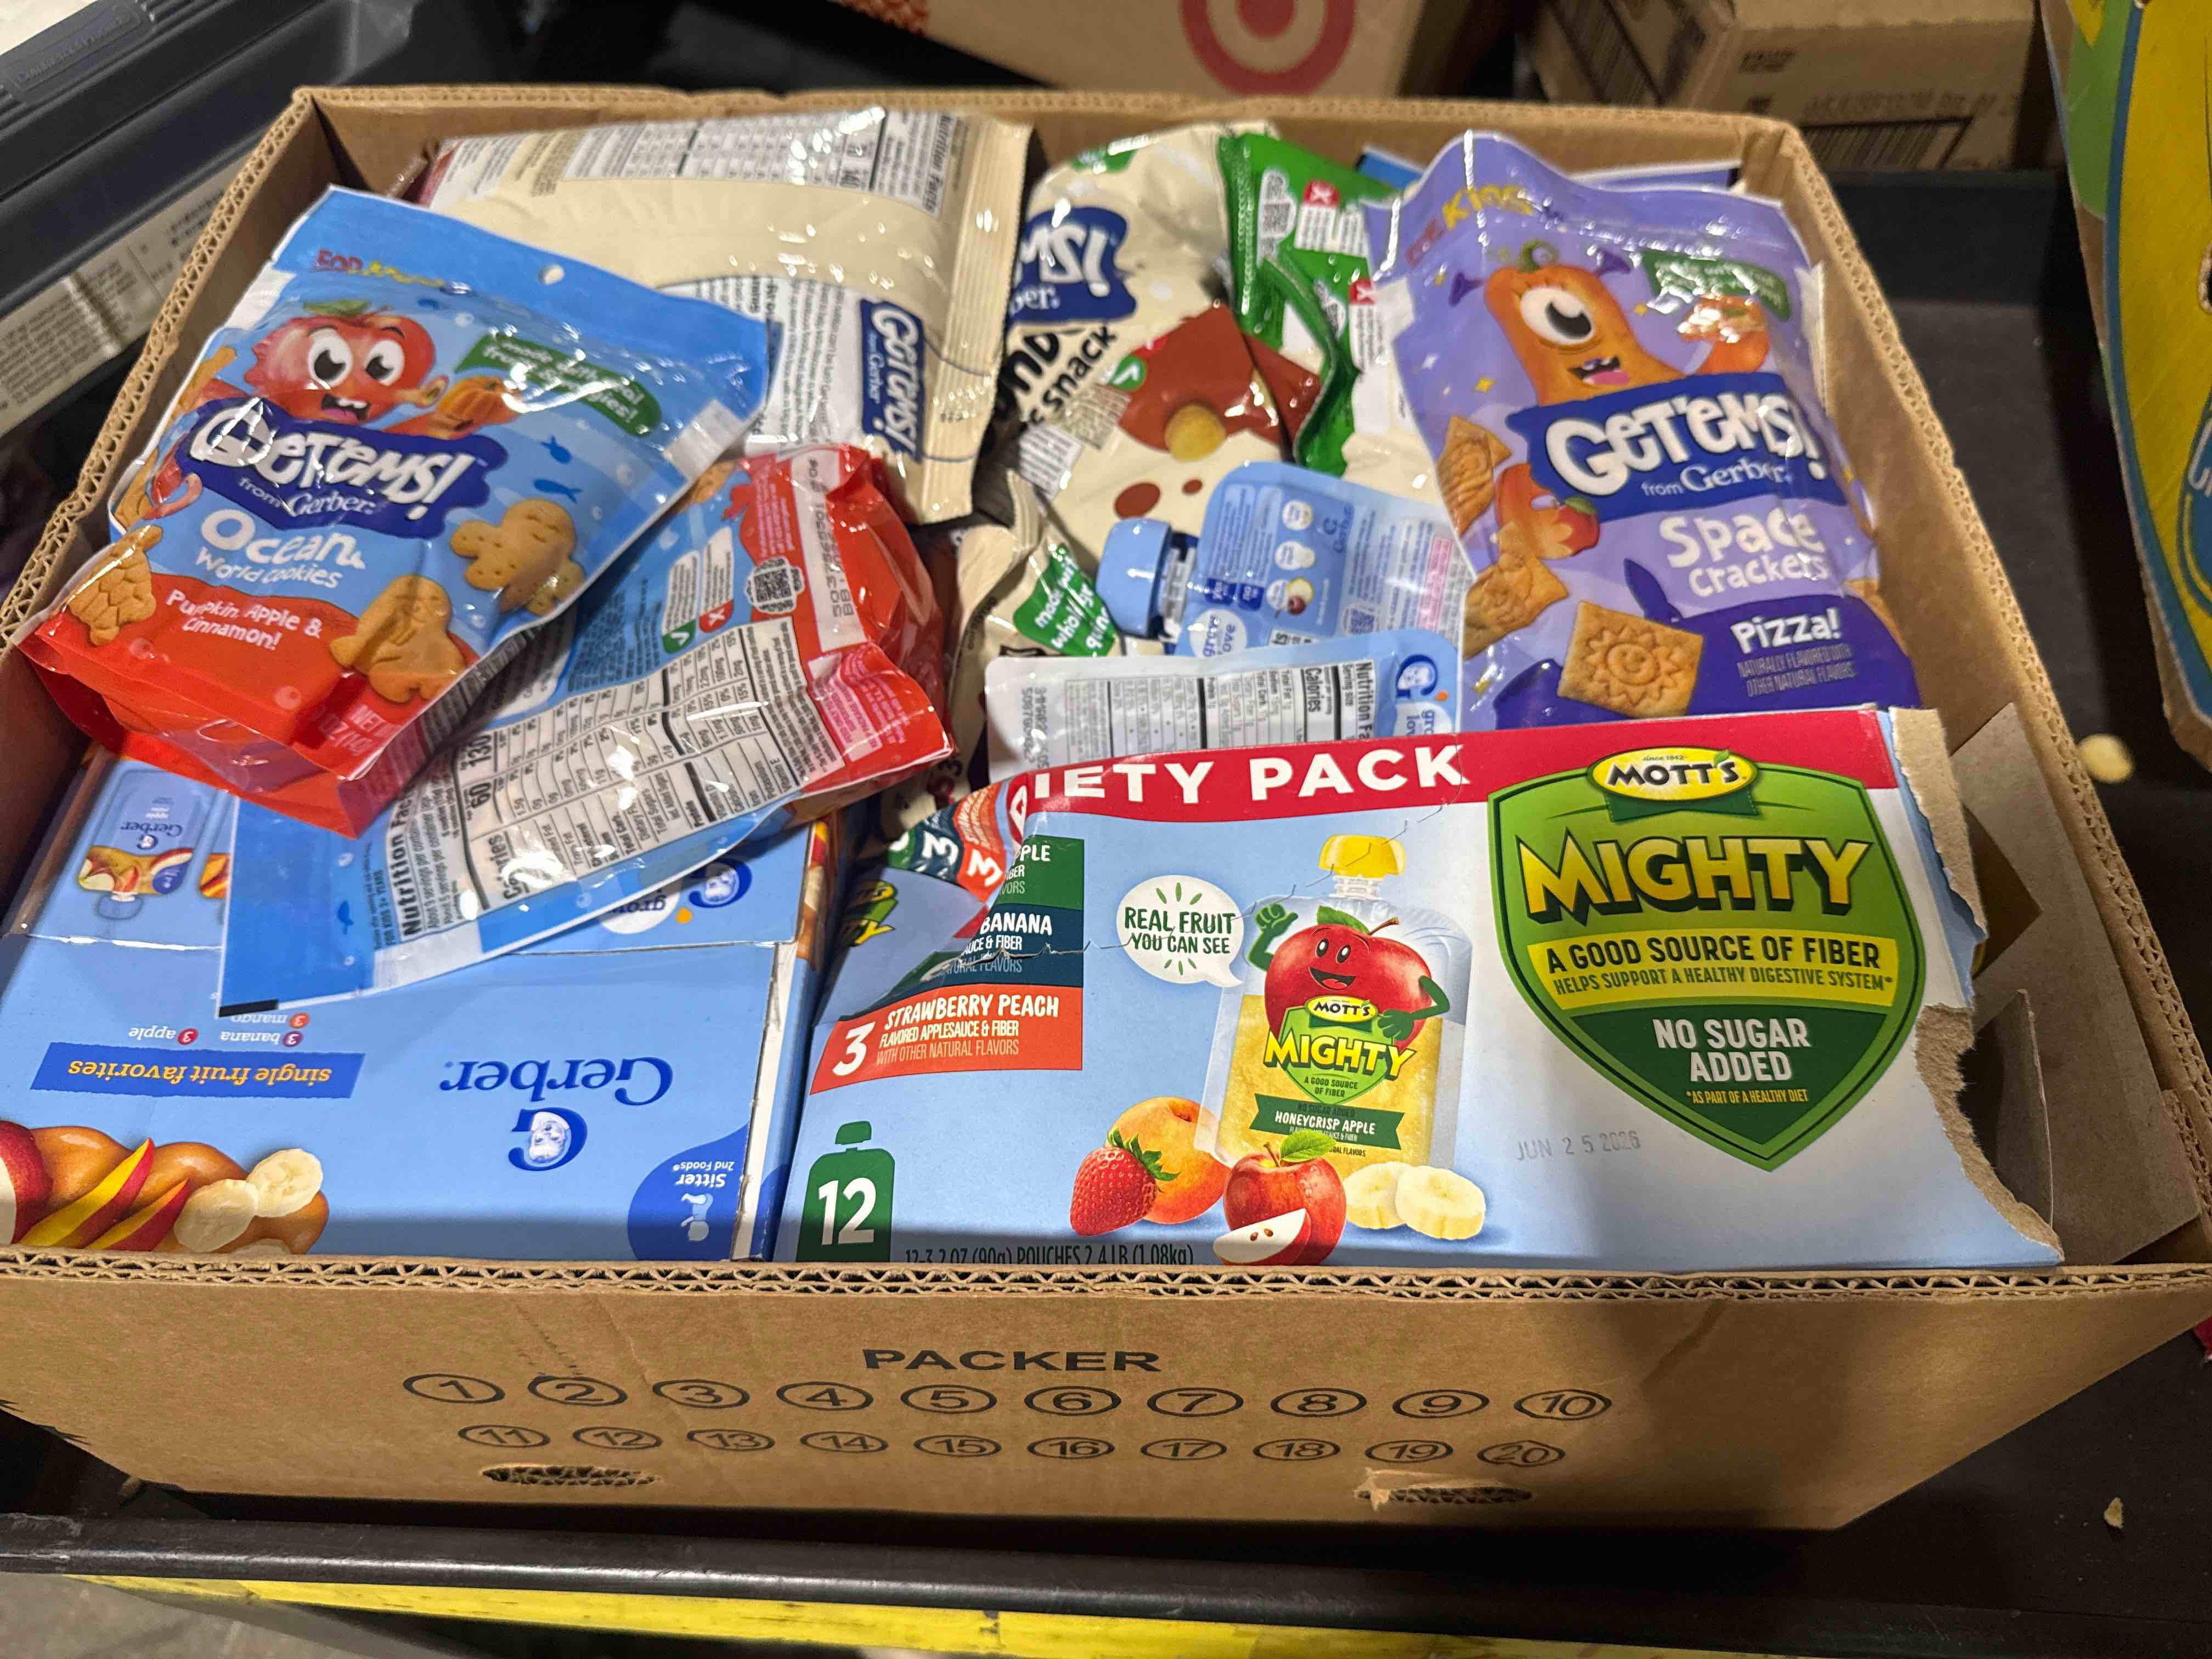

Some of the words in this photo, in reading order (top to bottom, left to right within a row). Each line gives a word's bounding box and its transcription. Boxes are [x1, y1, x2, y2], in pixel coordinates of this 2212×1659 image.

[1042, 326, 1118, 413] snack
[1641, 479, 1683, 496] from
[201, 509, 365, 569] Ocean
[1659, 508, 1826, 568] Space
[196, 547, 263, 582] World
[182, 617, 282, 650] Cinnamon!
[244, 603, 301, 631] Apple
[303, 617, 323, 639] &
[1730, 607, 1842, 654] Pizza!
[1305, 667, 1324, 713] Calories
[1355, 662, 1374, 720] Nutrition
[1421, 710, 1435, 734] gro
[470, 734, 492, 766] 130
[1034, 760, 1214, 805] IETY
[1250, 743, 1471, 803] PACK
[470, 782, 492, 808] 60
[390, 799, 411, 828] Fac
[120, 821, 183, 837] Gerber
[392, 834, 422, 935] Nutrition
[1515, 826, 1874, 926] MIGHTY
[980, 912, 1052, 935] BANANA
[1125, 907, 1173, 930] REAL
[1178, 911, 1236, 935] FRUIT
[986, 936, 993, 949] &
[996, 935, 1023, 951] FIBER
[1129, 933, 1163, 952] YOU
[1167, 935, 1199, 954] CAN
[1203, 936, 1231, 955] SEE
[1547, 947, 1567, 975] A
[1568, 938, 1641, 969] GOOD
[1649, 935, 1755, 963] SOURCE
[1762, 935, 1793, 963] OF
[1802, 937, 1880, 969] FIBER
[1553, 974, 1600, 996] HELPS
[1602, 969, 1667, 989] SUPPORT
[1671, 969, 1682, 984] A
[1684, 966, 1747, 984] HEALTHY
[1751, 966, 1825, 986] DIGESTIVE
[294, 1014, 305, 1026] 3
[884, 994, 994, 1030] STRAWBERRY
[997, 994, 1059, 1018] PEACH
[127, 1025, 176, 1041] apple
[183, 1030, 193, 1043] 3
[219, 1030, 281, 1045] banana
[287, 1032, 299, 1044] 3
[879, 1025, 919, 1048] FLAVORED
[921, 1020, 980, 1041] APPLESAUCE
[981, 1020, 989, 1037] &
[991, 1019, 1019, 1037] FIBER
[1652, 1018, 1697, 1049] NO
[1705, 1017, 1812, 1049] SUGAR
[832, 1021, 876, 1077] 3
[876, 1046, 898, 1066] WITH
[899, 1043, 927, 1062] OTHER
[929, 1040, 973, 1059] NATURAL
[975, 1039, 1019, 1056] FLAVORS
[1263, 1026, 1418, 1081] MIGHTY
[66, 1059, 190, 1085] favorites
[189, 1065, 251, 1085] fruit
[254, 1063, 332, 1086] single
[439, 1056, 674, 1106] Gerber
[1690, 1051, 1792, 1082] ADDED
[1310, 1077, 1330, 1087] GOOD
[1331, 1079, 1359, 1090] SOURCE
[1314, 1087, 1324, 1095] OF
[1325, 1088, 1346, 1098] FIBER
[1705, 1090, 1728, 1103] PART
[1728, 1090, 1740, 1103] OF
[1742, 1090, 1748, 1103] A
[1749, 1090, 1787, 1103] HEALTHY
[1787, 1088, 1809, 1102] DIET
[1274, 1110, 1341, 1130] HONEYCRISP
[1342, 1121, 1376, 1136] APPLE
[1516, 1138, 1553, 1161] JUN
[714, 1160, 735, 1171] 2nd
[674, 1173, 727, 1188] Sitter
[817, 1176, 877, 1246] 12
[861, 1347, 1163, 1374] PACKER
[437, 1380, 474, 1400] 1
[561, 1382, 606, 1404] 2
[679, 1384, 724, 1406] 3
[804, 1387, 849, 1408] 4
[927, 1389, 970, 1409] 5
[1051, 1391, 1093, 1411] 6
[1175, 1392, 1212, 1413] 7
[1295, 1393, 1339, 1414] 8
[1420, 1393, 1462, 1415] 9
[1539, 1393, 1597, 1417] 10
[477, 1429, 531, 1445] 11
[592, 1430, 644, 1447] 12
[704, 1431, 757, 1449] 13
[819, 1434, 869, 1450] 14
[934, 1436, 983, 1455] 15
[1050, 1440, 1096, 1458] 16
[1164, 1440, 1207, 1458] 17
[1277, 1440, 1324, 1459] 18
[1390, 1441, 1438, 1460] 19
[1493, 1444, 1550, 1464] 20
